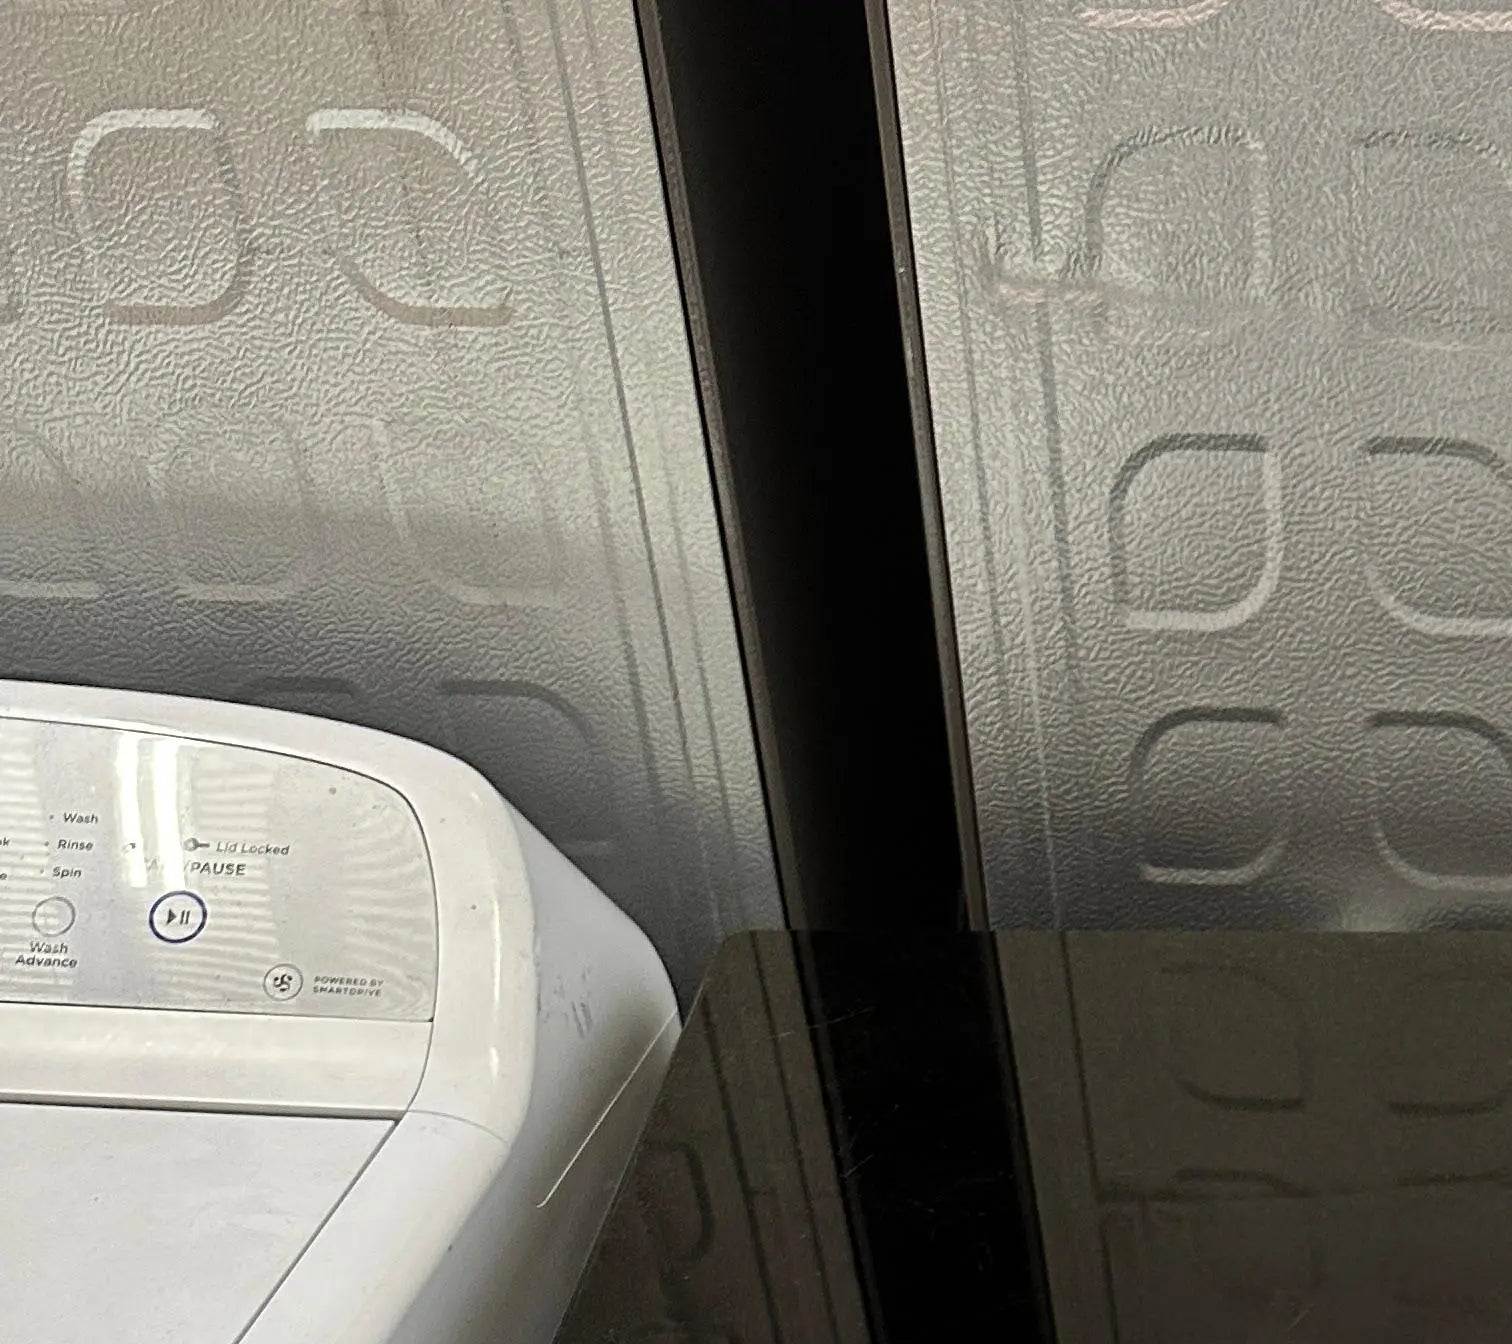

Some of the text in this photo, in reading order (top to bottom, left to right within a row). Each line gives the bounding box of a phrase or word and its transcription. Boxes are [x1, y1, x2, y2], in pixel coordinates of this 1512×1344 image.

[63, 812, 99, 824] Wash
[57, 839, 94, 851] Rinse
[215, 840, 291, 856] Lid Locked
[52, 866, 82, 880] Spin
[29, 941, 69, 954] Wash
[15, 954, 78, 968] Advance
[313, 976, 369, 986] POWERED
